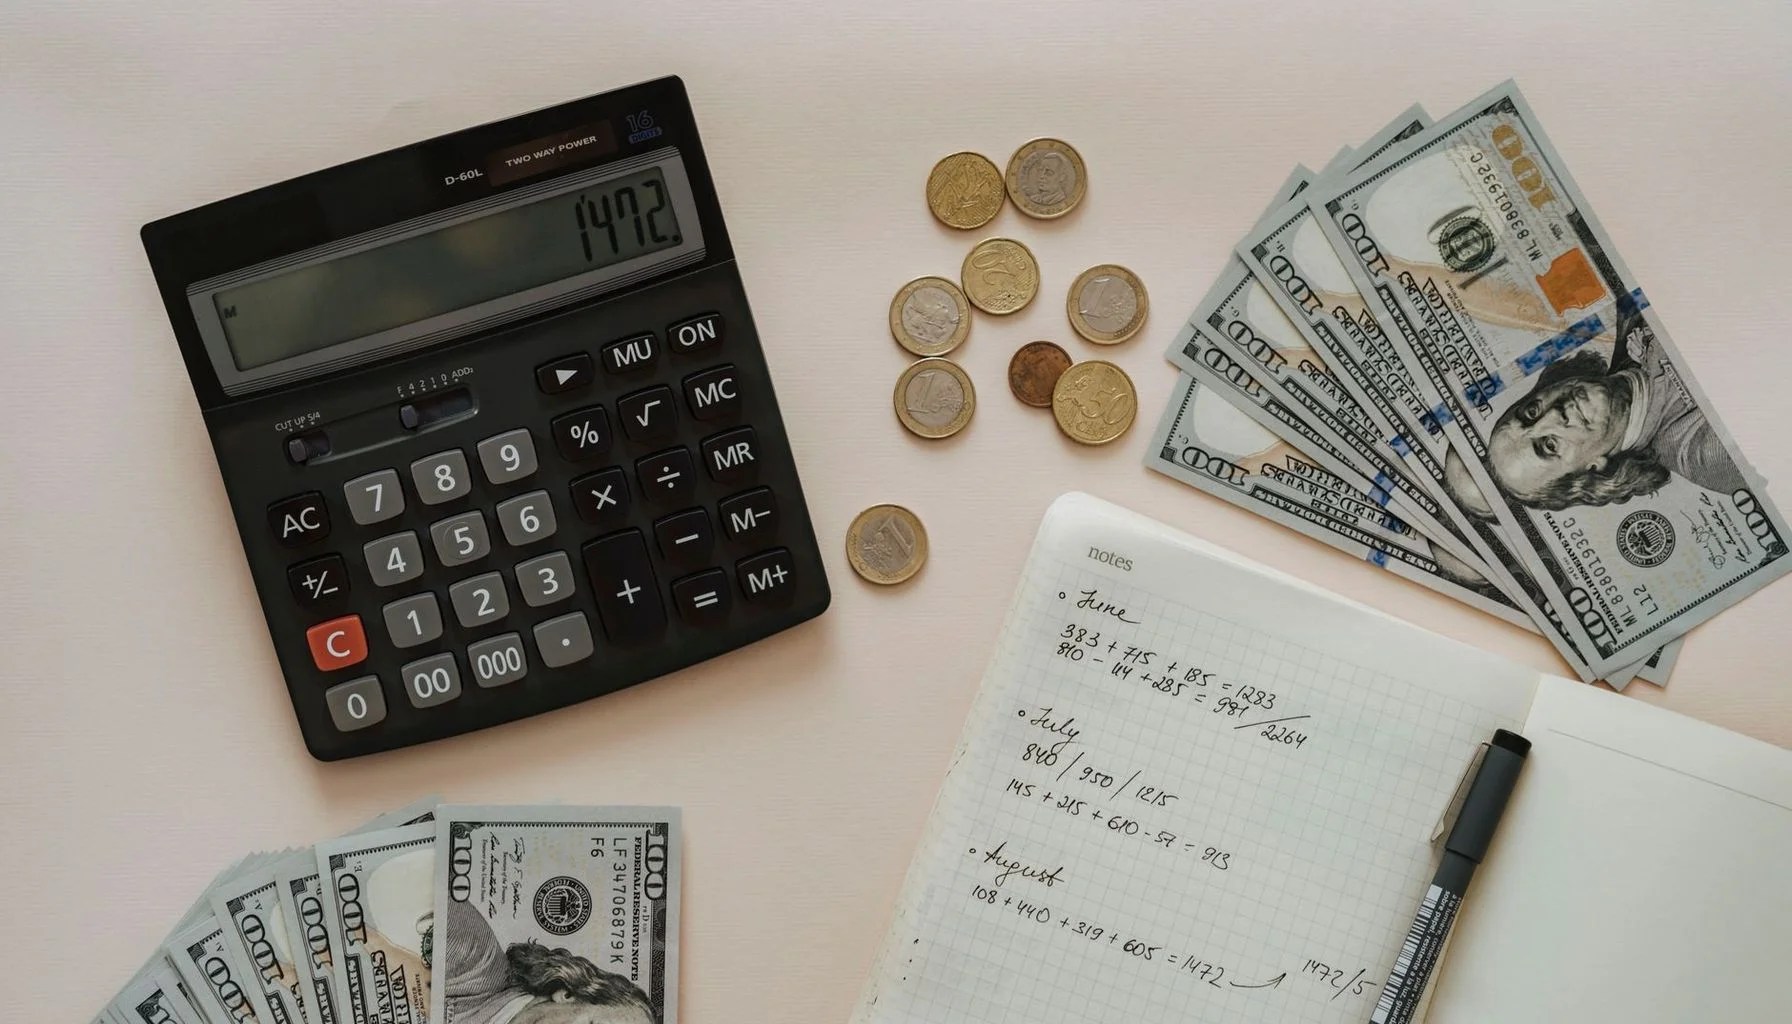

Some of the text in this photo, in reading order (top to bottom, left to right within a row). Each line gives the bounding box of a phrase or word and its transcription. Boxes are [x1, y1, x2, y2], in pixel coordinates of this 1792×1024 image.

[626, 111, 653, 132] 16
[631, 128, 660, 142] DIGITS
[505, 136, 598, 167] TWO WAY POWER
[1485, 119, 1558, 213] 100
[445, 168, 483, 186] D-60L
[1475, 162, 1531, 240] 83801932
[1338, 210, 1390, 278] 100
[1265, 251, 1324, 317] 100
[1395, 269, 1451, 347] STATES
[1417, 277, 1484, 371] AMERICA
[678, 321, 716, 346] ON
[1223, 316, 1288, 376] 100
[1330, 304, 1393, 377] STATES
[1418, 327, 1451, 374] THE
[614, 340, 652, 368] MU
[1314, 323, 1370, 388] DOLLARS
[1200, 343, 1265, 403] 100
[1377, 287, 1487, 457] ONE HUNDRED DOLLARS
[1439, 342, 1495, 420] UNITED
[695, 378, 736, 408] MC
[1284, 380, 1347, 435] DOLLARS
[275, 411, 320, 431] CUT UP 5/4
[571, 420, 600, 448] %
[1365, 386, 1421, 452] HUNDRED
[499, 444, 520, 470] 9
[714, 442, 754, 470] MR
[1178, 443, 1250, 488] 100
[1345, 432, 1411, 490] HUNDRED
[1418, 451, 1444, 480] ONE
[435, 465, 456, 491] 8
[1259, 461, 1341, 506] STATES
[366, 484, 384, 512] 7
[1408, 487, 1437, 514] ONE
[282, 507, 320, 538] AC
[520, 506, 540, 533] 6
[1253, 488, 1437, 572] ONE HUNDRED DOLLARS
[1544, 511, 1565, 540] NOTE
[1562, 516, 1576, 529] C
[1728, 485, 1781, 554] 100
[454, 527, 474, 555] 5
[387, 548, 406, 573] 4
[1088, 546, 1133, 572] notes
[1560, 538, 1594, 588] RESERVE
[1569, 527, 1624, 605] 83801932
[539, 568, 559, 594] 3
[749, 564, 788, 593] M+
[473, 589, 495, 614] 2
[1078, 590, 1141, 624] June
[1589, 586, 1623, 634] FEDERAL
[1617, 604, 1637, 627] ML
[1632, 583, 1658, 615] L12
[407, 610, 422, 634] 1
[1565, 584, 1618, 653] 100
[328, 631, 350, 657] C
[477, 647, 521, 677] 000
[1061, 624, 1100, 647] 383
[1124, 647, 1157, 665] 715
[1184, 667, 1216, 686] 185
[1236, 685, 1276, 709] 1283
[414, 668, 450, 697] 00
[1057, 643, 1083, 660] 810
[1152, 677, 1188, 696] 285
[1214, 698, 1250, 717] 981
[347, 694, 367, 718] 0
[1031, 708, 1081, 754] July
[1261, 725, 1307, 749] 2264
[1023, 744, 1057, 765] 840
[1080, 767, 1113, 787] 950
[1136, 787, 1179, 806] 1215
[1007, 779, 1036, 797] 145
[1057, 797, 1087, 815] 215
[1108, 816, 1138, 835] 610
[1155, 832, 1176, 847] 57
[1202, 848, 1230, 870] 913
[590, 837, 603, 857] F6
[984, 842, 1064, 886] August
[451, 833, 471, 902] 100
[644, 830, 664, 900] 100
[333, 871, 370, 946] 100
[610, 837, 626, 963] LF 34706879 K
[630, 836, 641, 981] FEDERAL RESERVE NOTE
[1436, 889, 1451, 911] sobre
[1448, 899, 1455, 908] la
[297, 895, 335, 969] 100
[972, 886, 997, 904] 108
[1018, 900, 1050, 923] 440
[1072, 922, 1103, 940] 319
[1124, 940, 1162, 960] 605
[1182, 955, 1224, 988] 1472
[1426, 910, 1442, 935] papel,
[1434, 907, 1453, 937] lumière,
[238, 911, 284, 986] 100
[1411, 935, 1432, 971] resistente
[1419, 937, 1440, 972] conserver
[201, 951, 256, 1024] 100
[1405, 977, 1414, 985] la
[1410, 977, 1423, 992] plat
